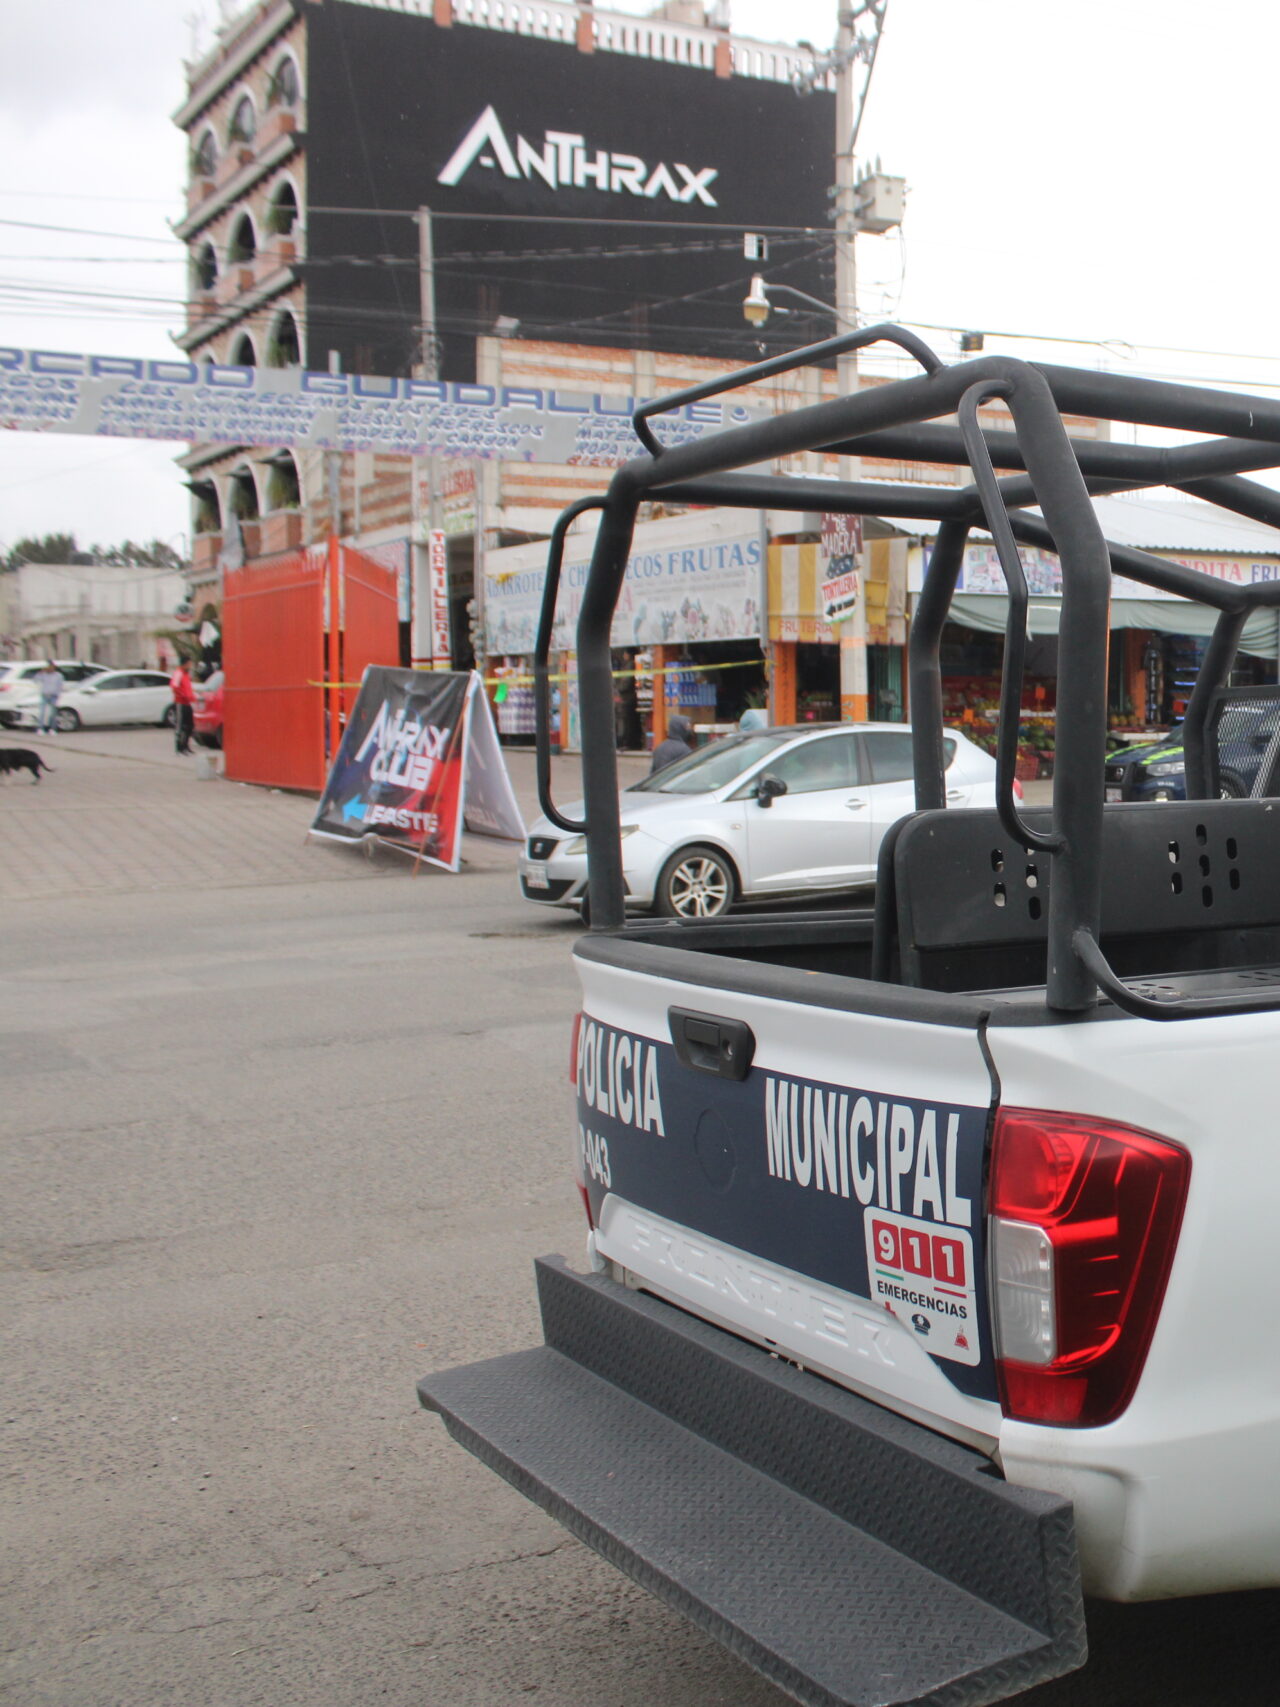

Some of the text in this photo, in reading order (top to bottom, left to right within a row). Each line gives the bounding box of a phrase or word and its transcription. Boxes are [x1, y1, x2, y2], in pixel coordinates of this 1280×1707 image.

[437, 104, 719, 207] ANTHRAX
[301, 370, 722, 424] GUADALUE
[396, 401, 499, 419] USTEDES
[429, 418, 543, 435] REFRESCOS
[446, 433, 520, 446] CARBON
[667, 540, 761, 575] FRUTAS
[431, 532, 449, 653] TORTILLERIA
[577, 1017, 972, 1227] POLICIA MUNICIPAL
[878, 1229, 955, 1278] 911
[877, 1280, 967, 1319] EMERGENCIAS
